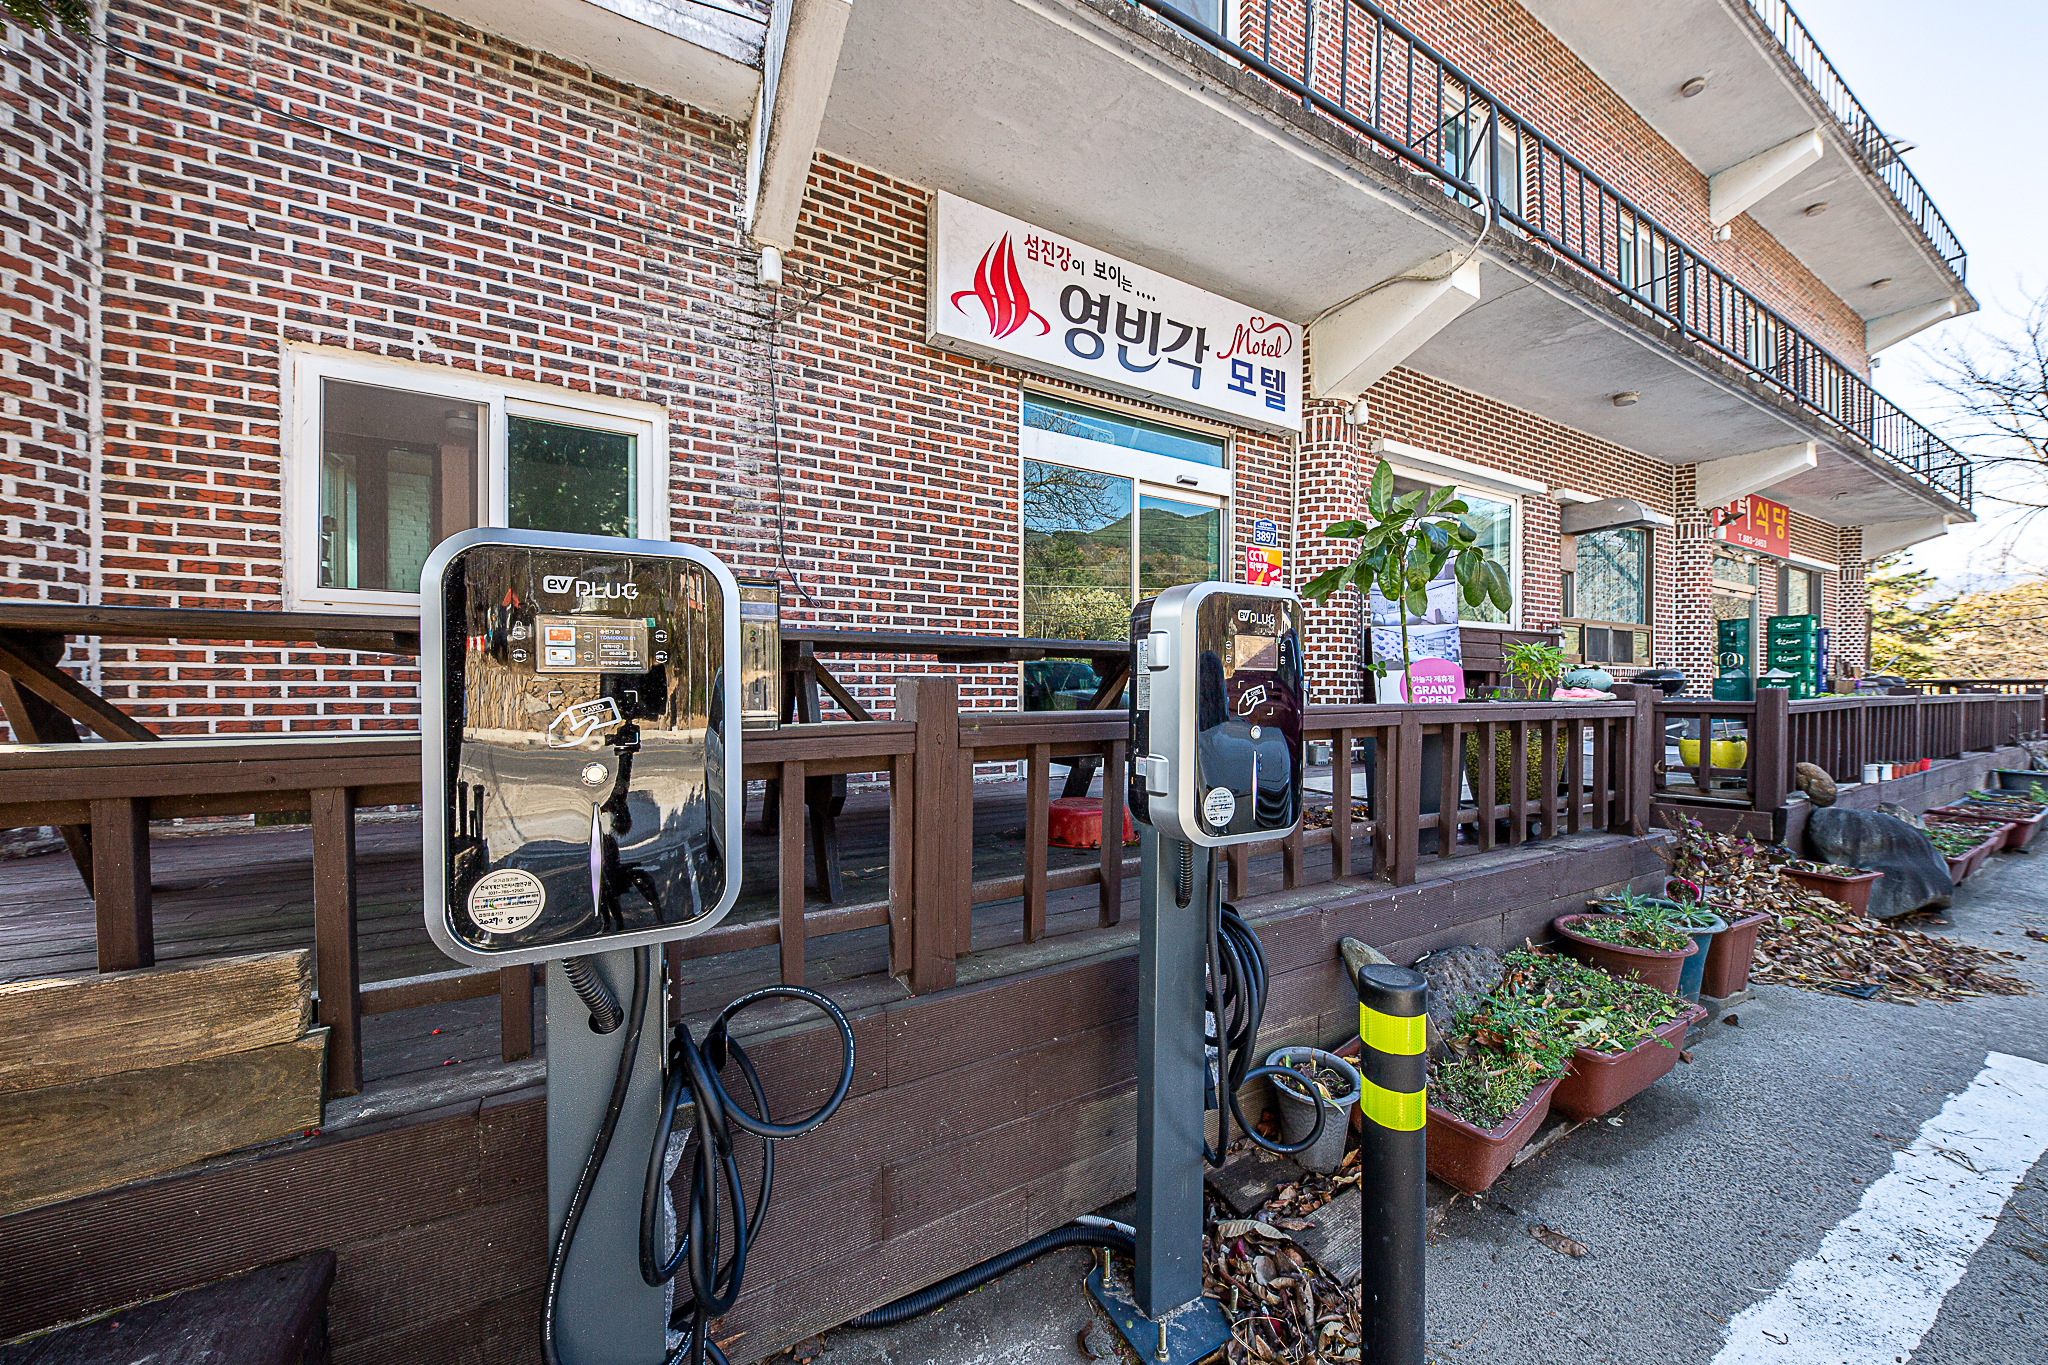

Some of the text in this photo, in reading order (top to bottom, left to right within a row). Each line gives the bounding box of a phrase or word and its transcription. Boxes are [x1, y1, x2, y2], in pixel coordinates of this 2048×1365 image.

[1024, 233, 1084, 276] 섬진강이
[1060, 284, 1210, 390] 영빈각
[1217, 316, 1292, 360] Motel
[1227, 357, 1286, 412] 모텔
[1255, 530, 1276, 543] 3897
[1248, 550, 1269, 563] CCTV
[1412, 685, 1457, 695] GRAND
[1418, 695, 1452, 704] OPEN
[580, 703, 605, 716] CARD
